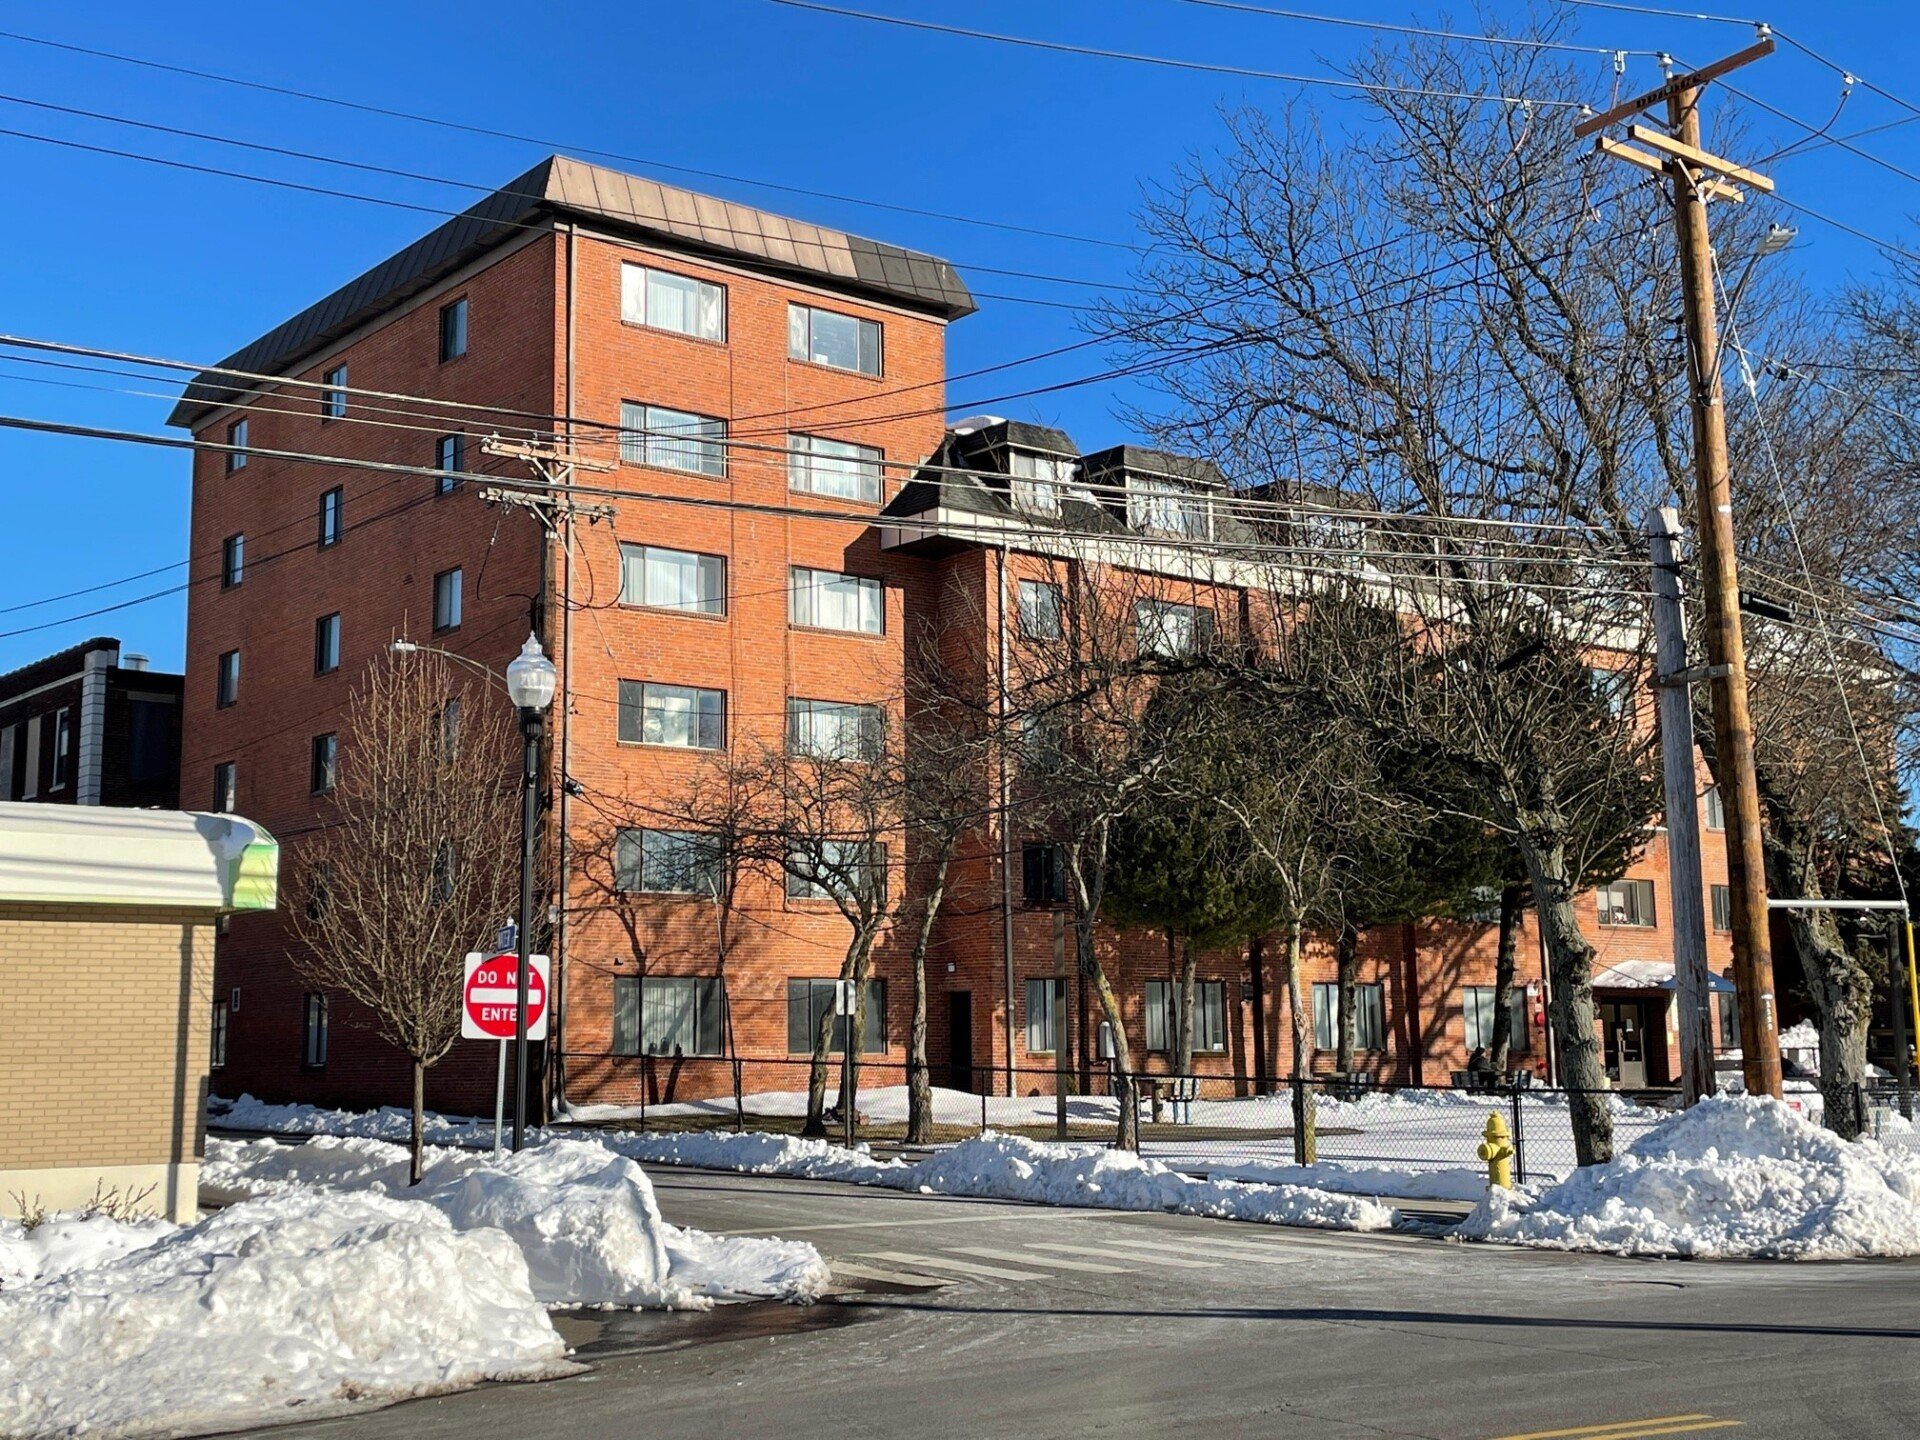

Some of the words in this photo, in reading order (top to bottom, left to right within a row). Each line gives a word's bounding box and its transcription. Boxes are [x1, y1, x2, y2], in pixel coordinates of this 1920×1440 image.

[478, 971, 498, 984] DO
[506, 972, 535, 985] NT
[482, 1008, 518, 1021] ENTE
